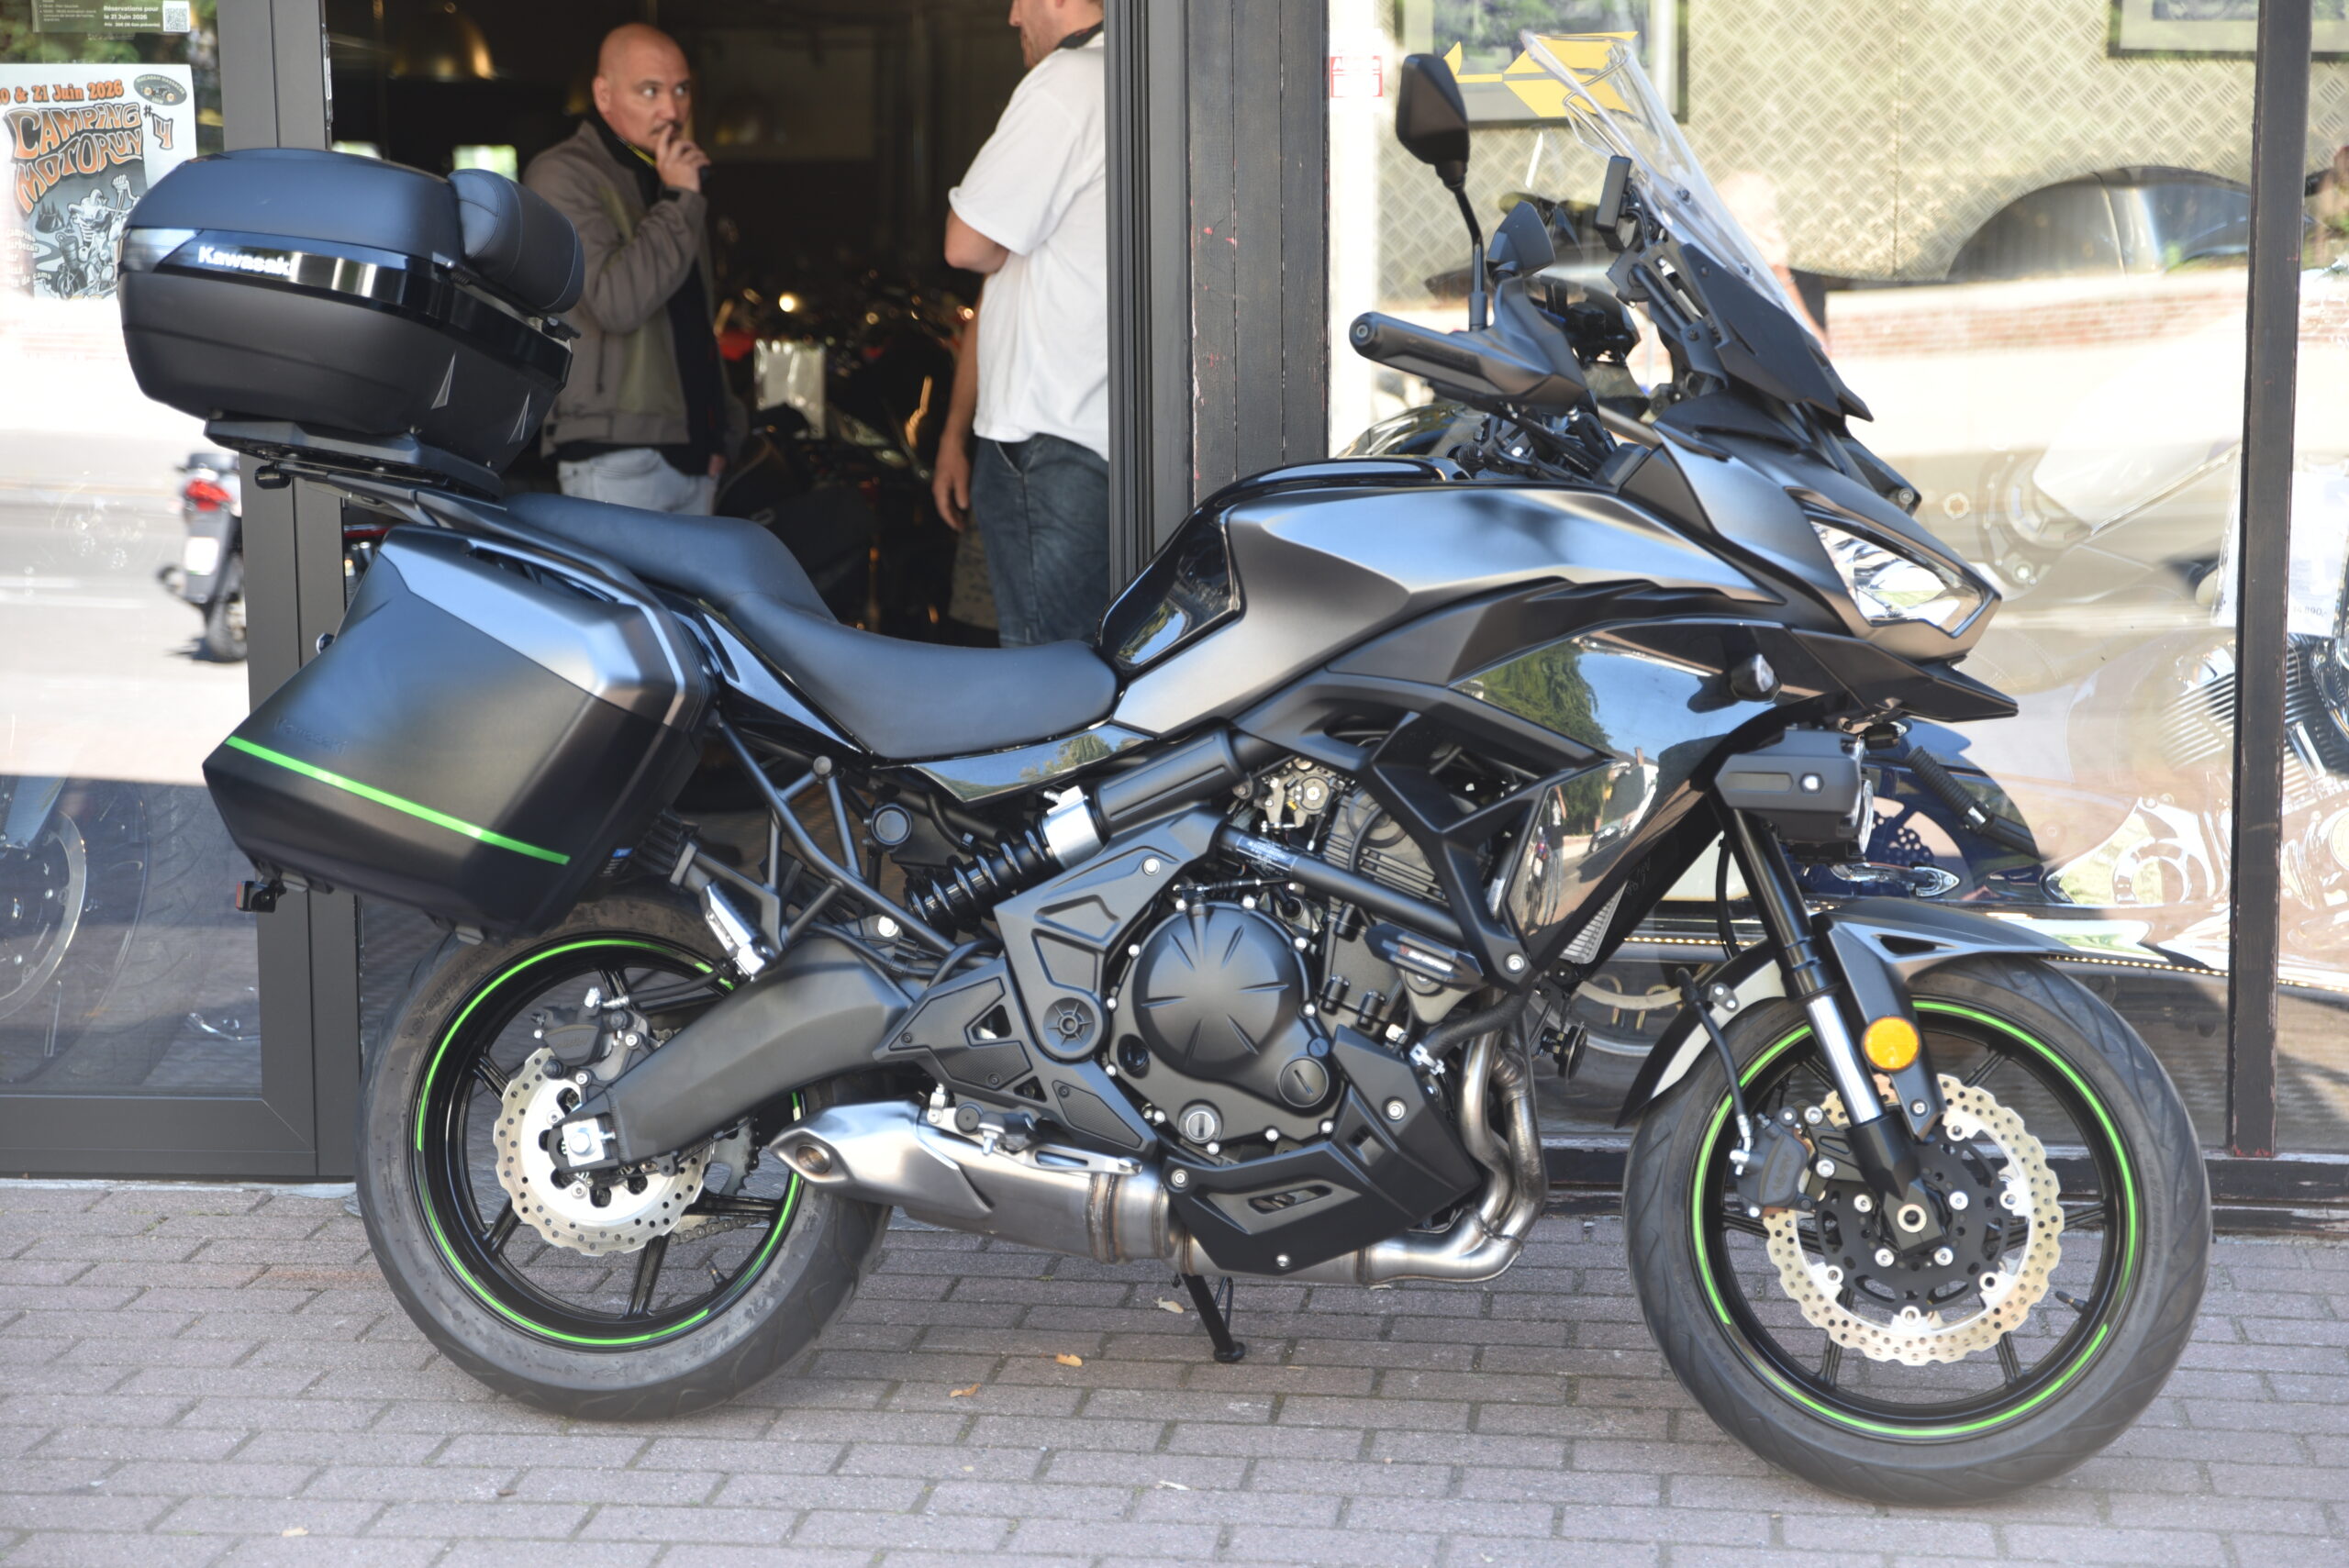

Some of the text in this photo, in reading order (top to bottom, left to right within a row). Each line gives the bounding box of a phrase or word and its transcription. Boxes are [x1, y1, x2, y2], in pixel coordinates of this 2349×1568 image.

[0, 79, 124, 105] 0 & 21 Juin 2026
[15, 128, 143, 214] MOTORUN
